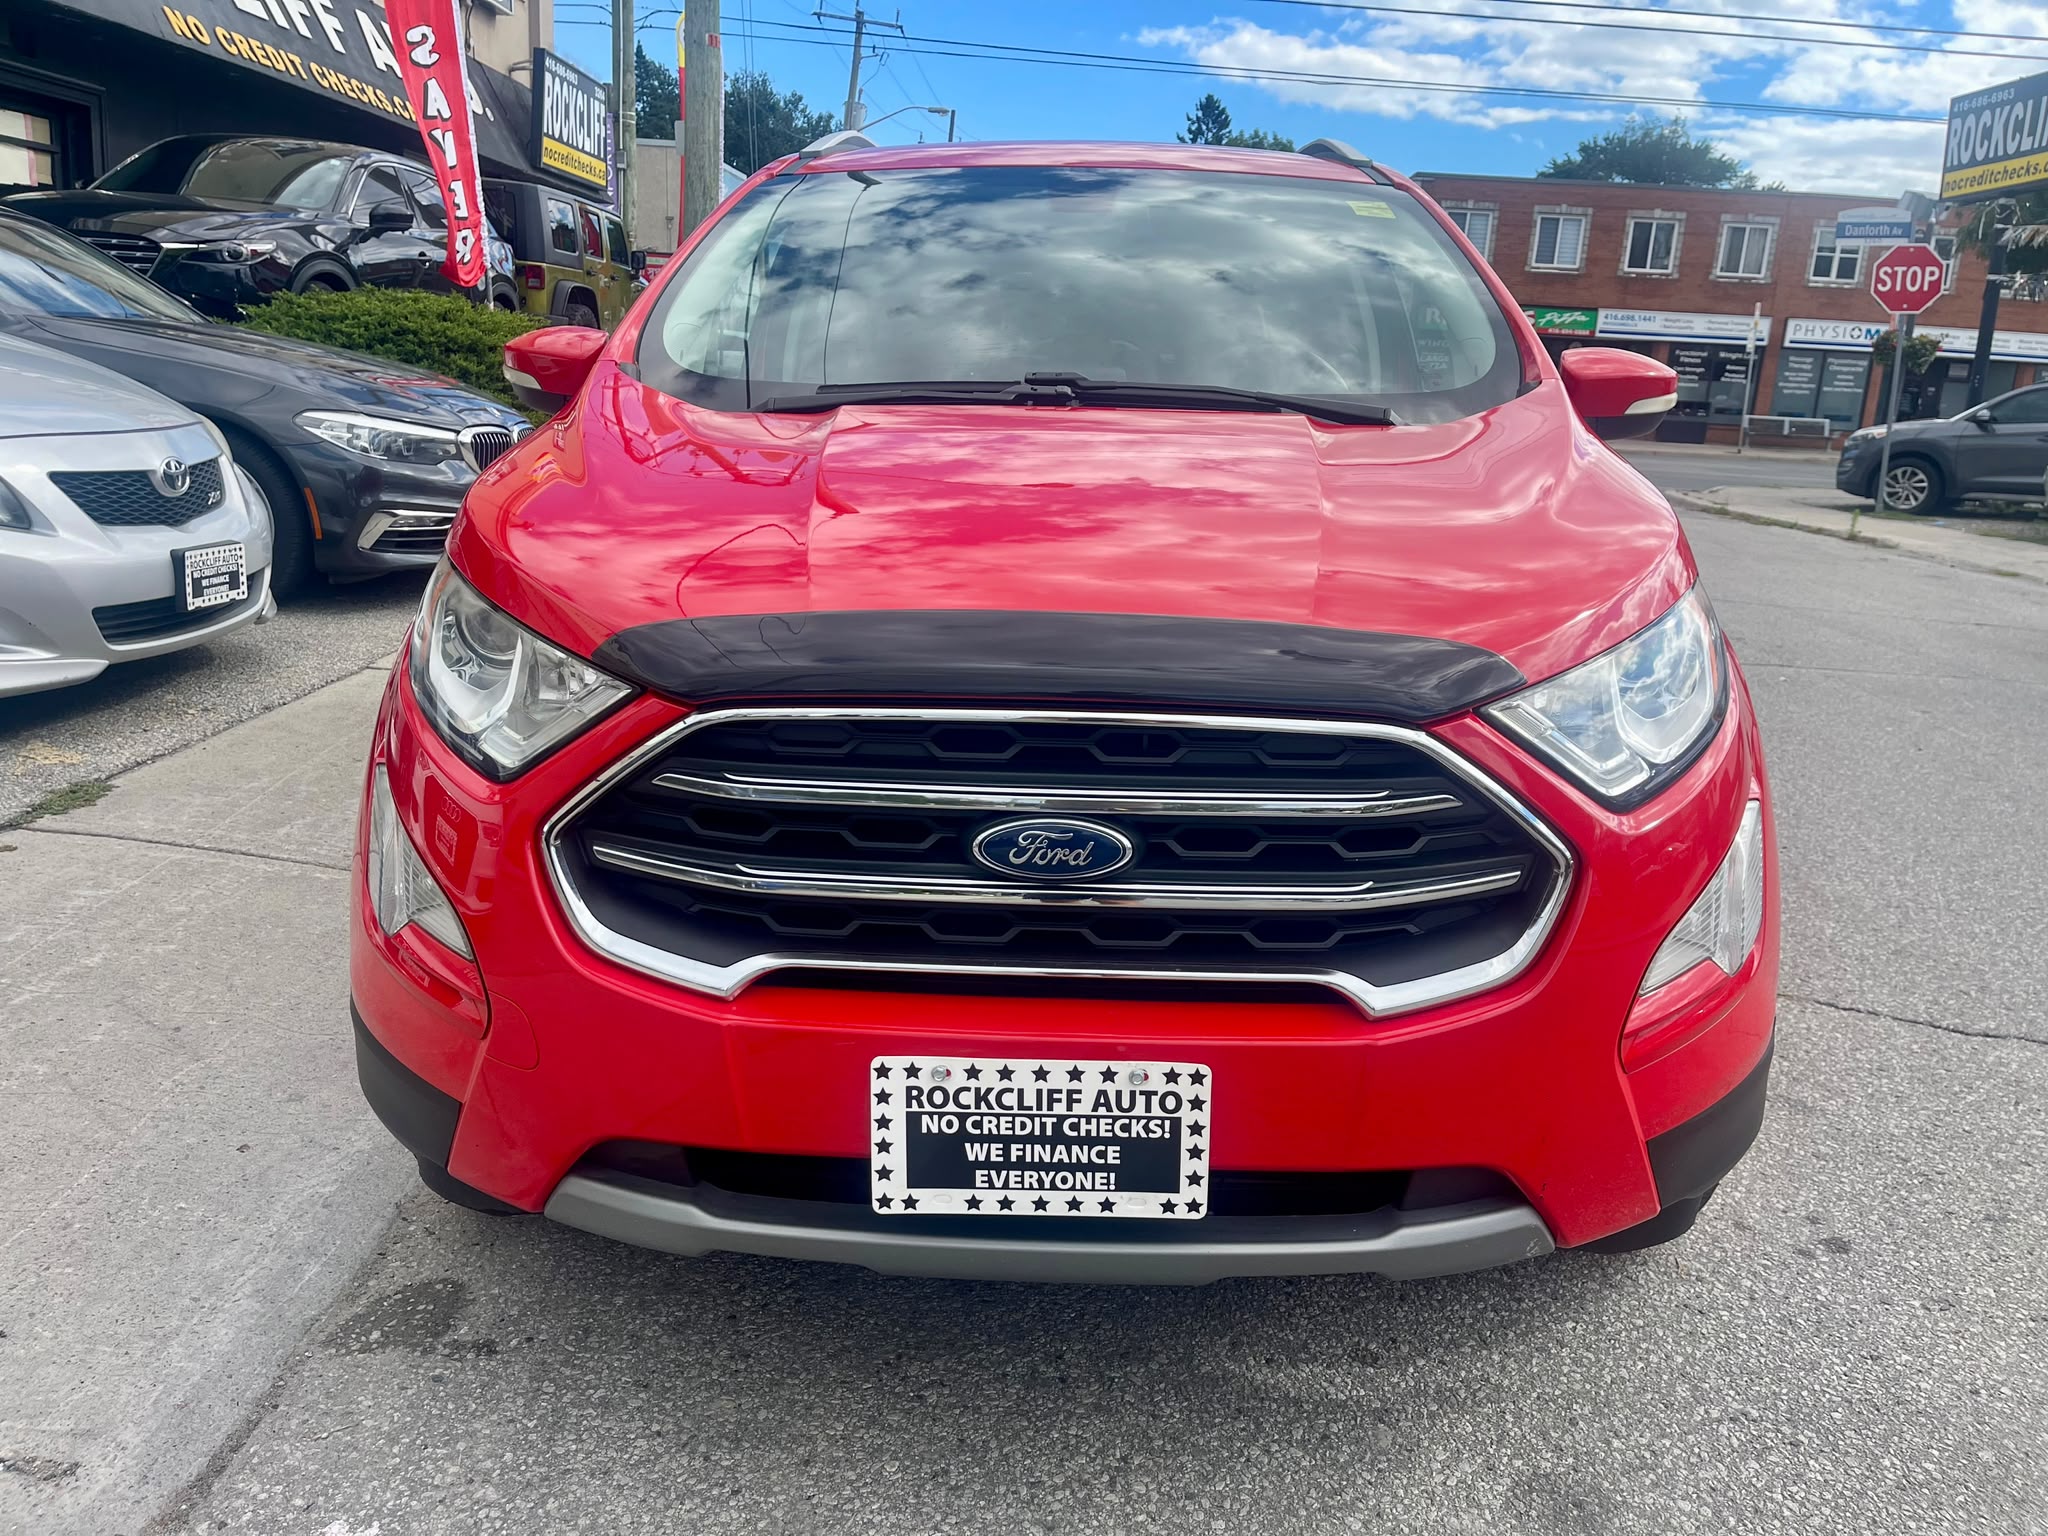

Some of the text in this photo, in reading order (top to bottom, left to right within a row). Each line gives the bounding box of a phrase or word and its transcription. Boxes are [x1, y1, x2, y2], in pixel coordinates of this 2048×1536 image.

[162, 5, 211, 45] NO
[214, 26, 308, 80] CREDIT
[543, 71, 606, 158] ROCKCLIFF
[543, 146, 606, 181] nocreditchecks.ca
[1845, 224, 1890, 236] Danforth
[1877, 266, 1940, 292] STOP
[190, 553, 238, 570] ROCKCLIFF AUTO
[202, 567, 218, 577] CREDIT
[1009, 831, 1094, 866] Ford
[905, 1085, 1183, 1115] ROCKCLIFF AUTO
[921, 1114, 1172, 1139] NO CREDIT CHECKS!
[964, 1142, 1121, 1165] WE FINANCE
[975, 1169, 1117, 1191] EVERYONE!
